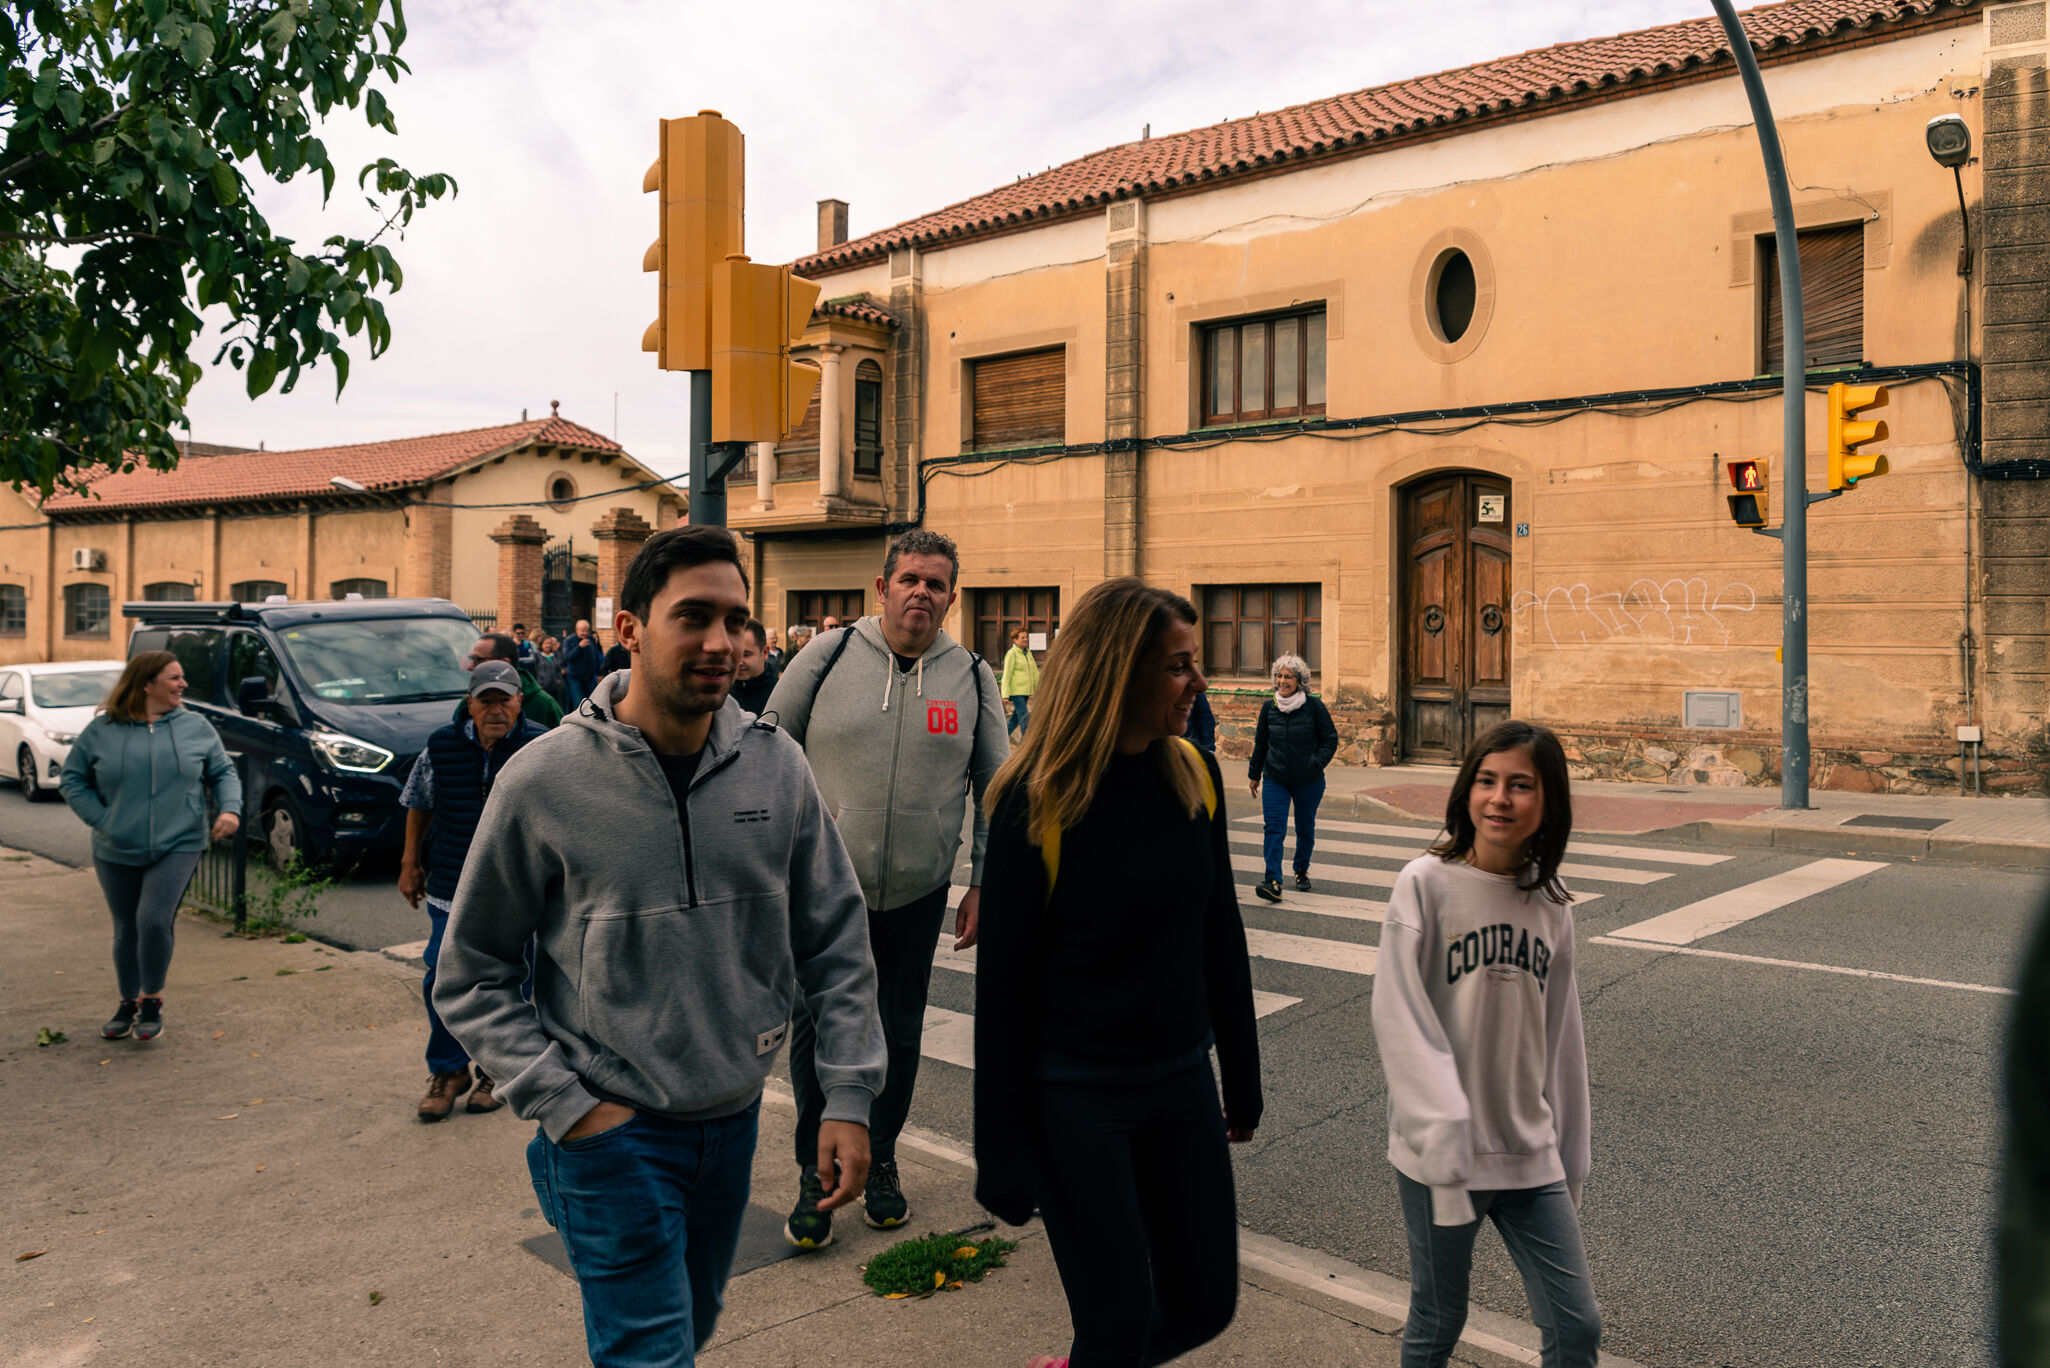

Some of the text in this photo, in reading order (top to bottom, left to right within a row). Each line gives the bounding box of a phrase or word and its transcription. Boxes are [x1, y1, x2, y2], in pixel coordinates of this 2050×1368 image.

[1518, 524, 1528, 536] 26
[926, 699, 957, 708] CONVERSE
[927, 707, 958, 735] 08
